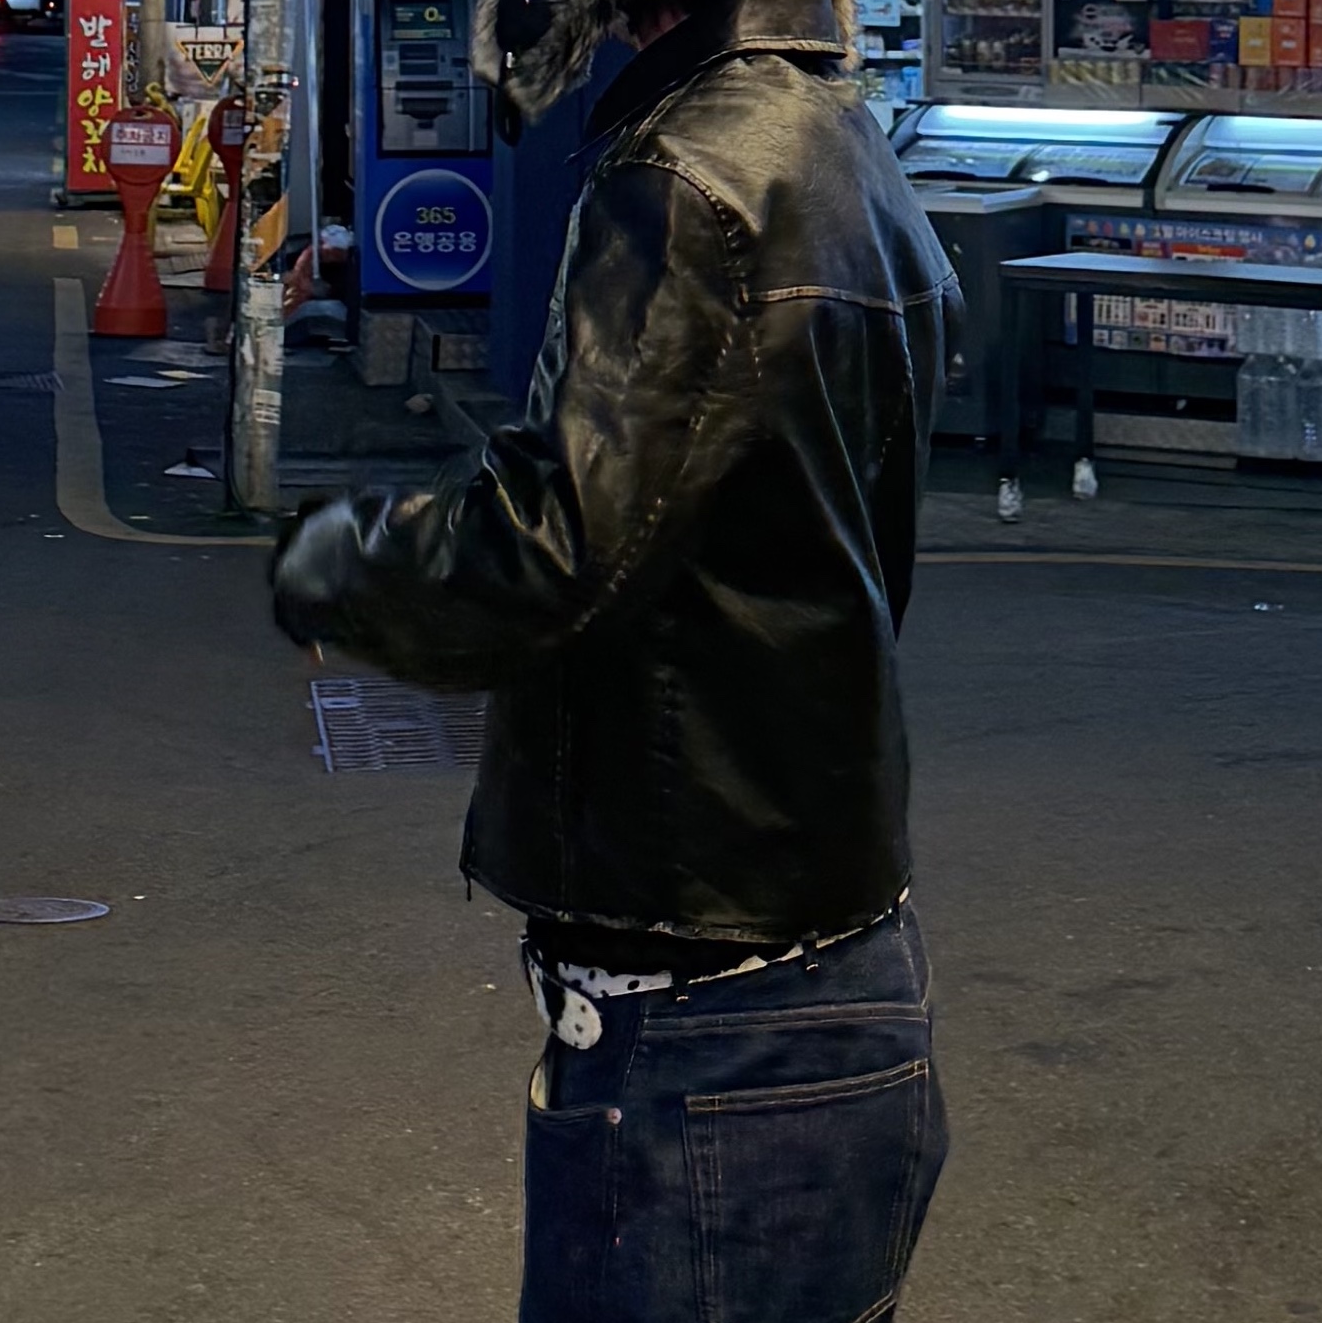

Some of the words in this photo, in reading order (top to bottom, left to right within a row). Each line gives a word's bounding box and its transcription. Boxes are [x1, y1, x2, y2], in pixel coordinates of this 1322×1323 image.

[184, 43, 234, 62] TERRA
[114, 126, 170, 144] 주차금지
[416, 206, 456, 225] 365
[392, 230, 478, 253] 은행공용
[1175, 225, 1237, 243] 아이스크림
